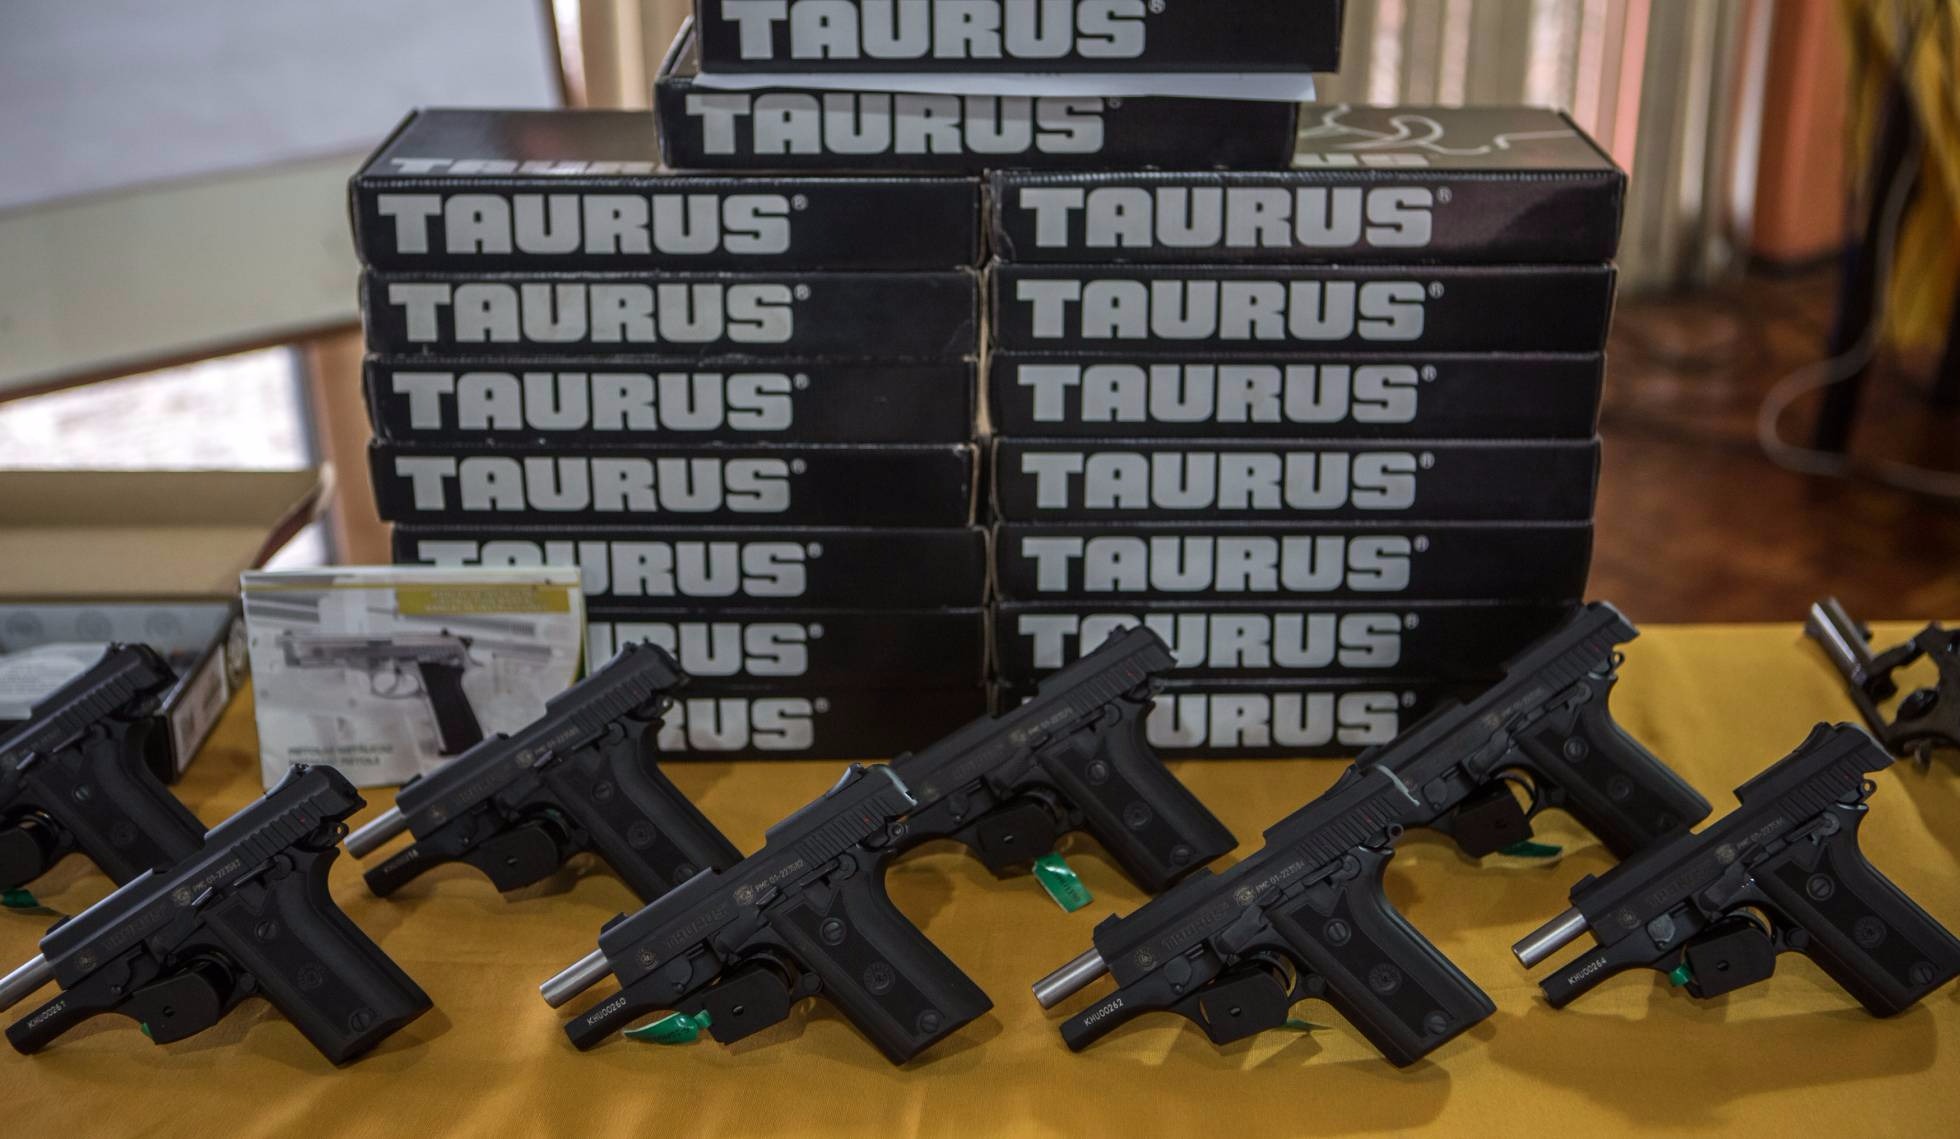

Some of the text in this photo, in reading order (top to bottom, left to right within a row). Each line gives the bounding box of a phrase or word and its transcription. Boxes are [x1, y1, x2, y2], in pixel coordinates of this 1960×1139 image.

[722, 0, 1145, 59] TAURUS
[686, 95, 1104, 154] TAURUS
[378, 195, 790, 254] TAURUS
[1020, 187, 1433, 247] TAURUS
[389, 284, 793, 343] TAURUS
[1017, 280, 1425, 340] TAURUS
[393, 373, 793, 431] TAURUS
[1018, 365, 1418, 422] TAURUS
[396, 457, 789, 512] TAURUS
[1022, 453, 1416, 509] TAURUS
[1022, 537, 1410, 591] TAURUS
[1083, 998, 1124, 1027] KHU00262
